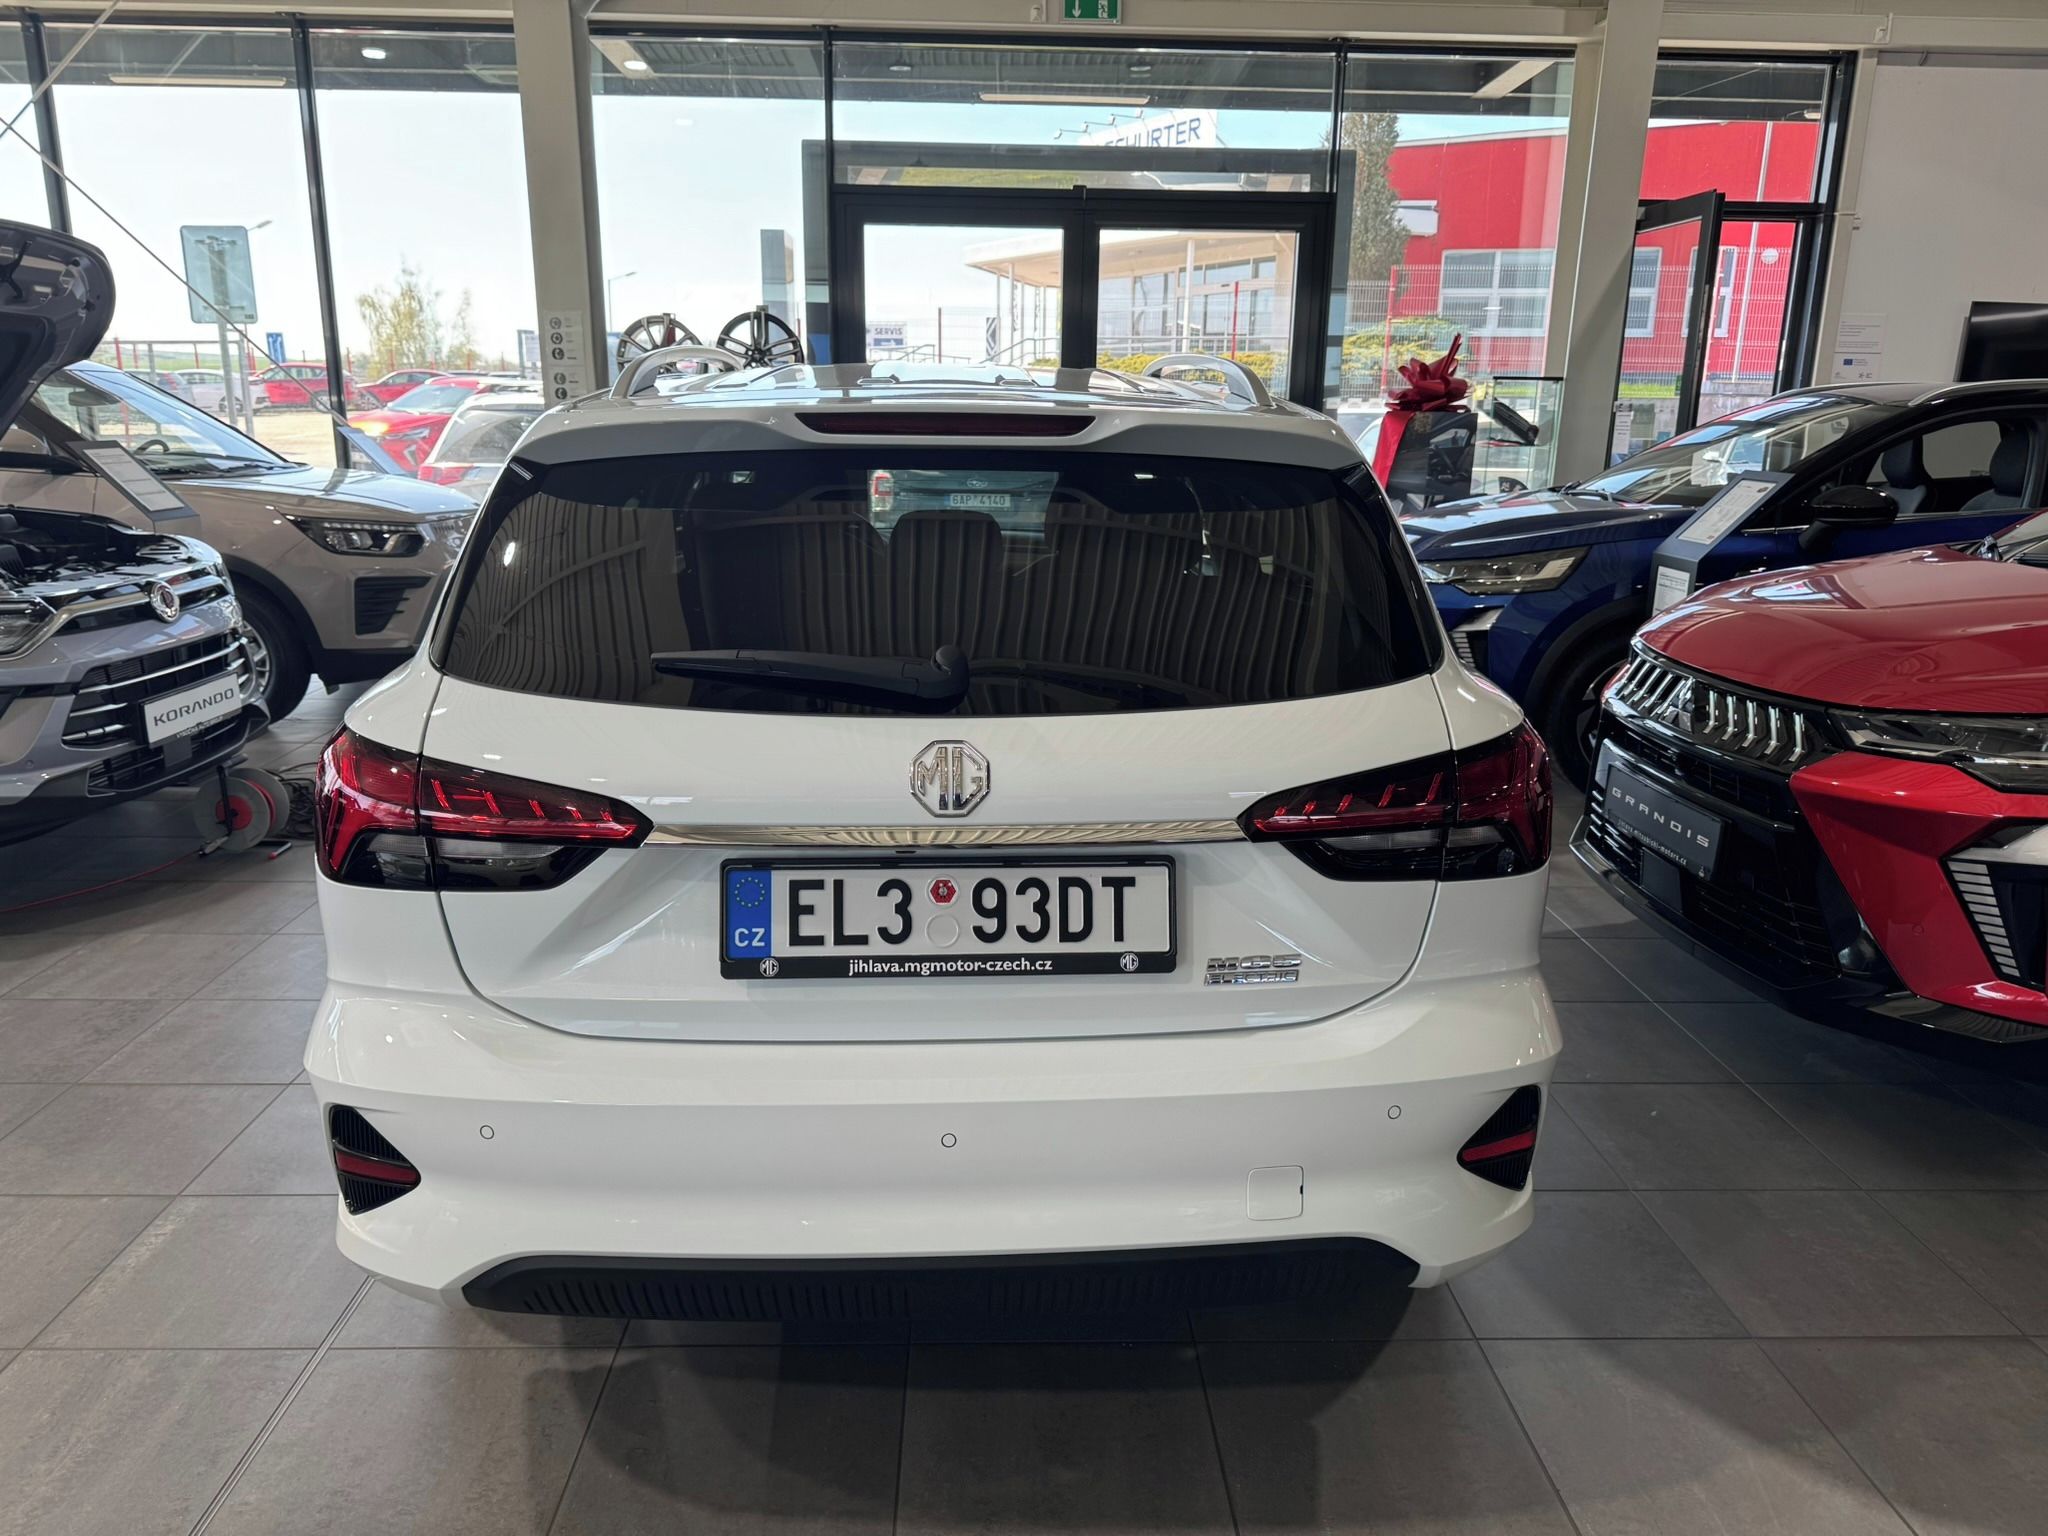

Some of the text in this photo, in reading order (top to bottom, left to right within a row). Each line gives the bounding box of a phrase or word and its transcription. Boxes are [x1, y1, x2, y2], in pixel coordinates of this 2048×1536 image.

[1104, 116, 1201, 147] HURTER
[874, 327, 904, 336] SERVIS
[952, 495, 1006, 506] 6AP 4140
[153, 688, 235, 727] KORANDO
[914, 742, 986, 814] MG
[1612, 787, 1710, 848] GRANDIS
[788, 876, 1136, 947] EL3 93DT
[734, 928, 765, 947] CZ
[760, 958, 779, 977] MG
[849, 957, 1053, 976] jihlava.mgmotor-czech.cz
[1120, 953, 1139, 972] MG
[1206, 955, 1302, 972] MG5
[1203, 969, 1299, 986] ELECTRIC
